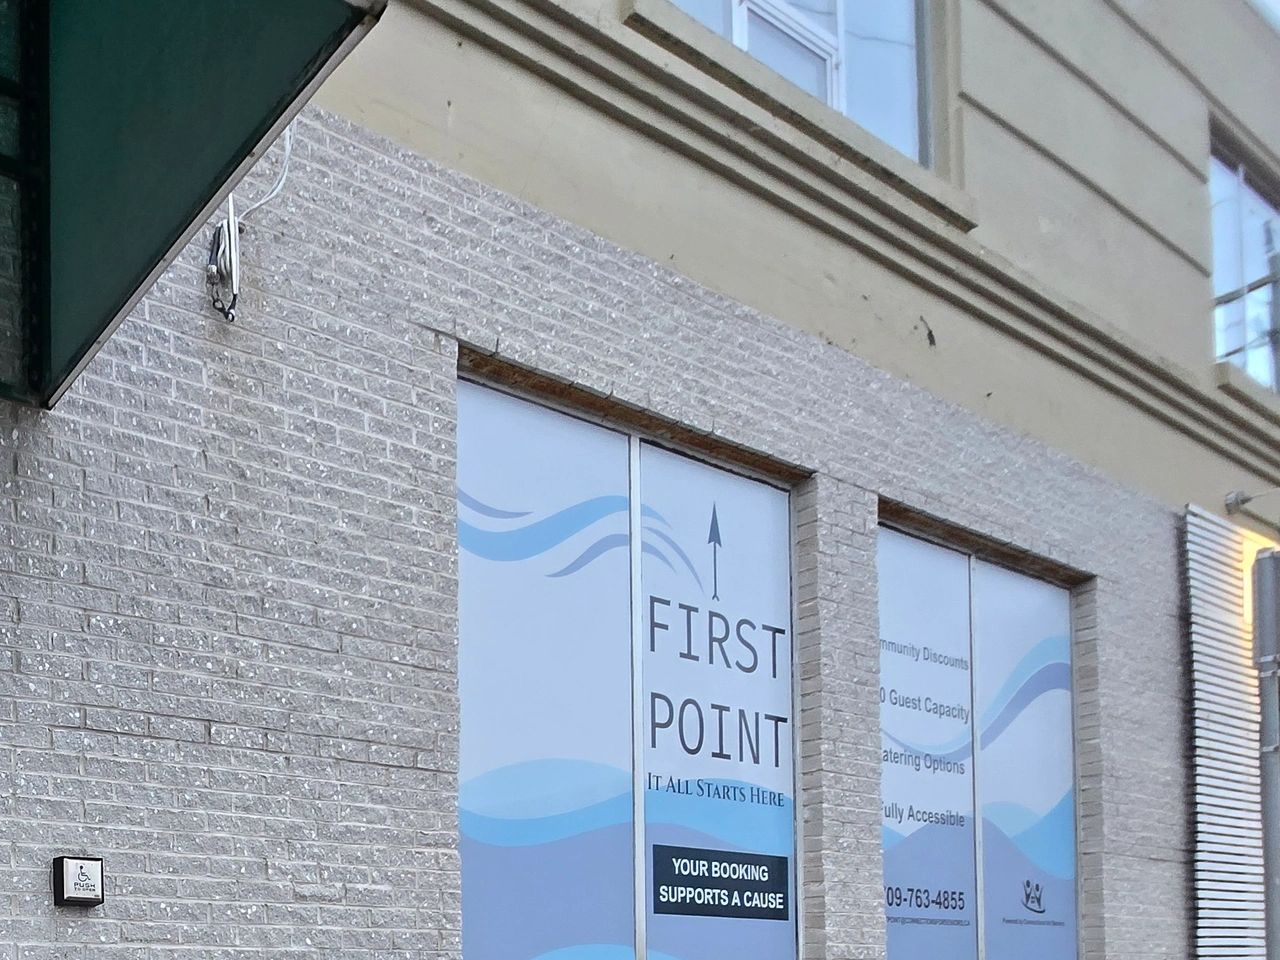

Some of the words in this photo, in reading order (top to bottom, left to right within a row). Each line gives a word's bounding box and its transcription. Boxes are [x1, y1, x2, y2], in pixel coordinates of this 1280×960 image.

[649, 595, 786, 679] FIRST
[880, 638, 920, 662] mmunity
[923, 646, 969, 671] Discounts
[880, 686, 886, 703] 0
[889, 689, 921, 711] Guest
[924, 697, 970, 725] Capacity
[650, 691, 788, 768] POINT
[882, 747, 920, 772] atering
[924, 753, 965, 775] Options
[881, 801, 904, 824] ully
[907, 804, 965, 828] Accessible
[672, 858, 709, 877] YOUR
[711, 862, 769, 882] BOOKING
[659, 885, 728, 906] SUPPORTS
[731, 891, 741, 907] A
[744, 891, 784, 909] CAUSE
[884, 886, 965, 910] 09-763-4855
